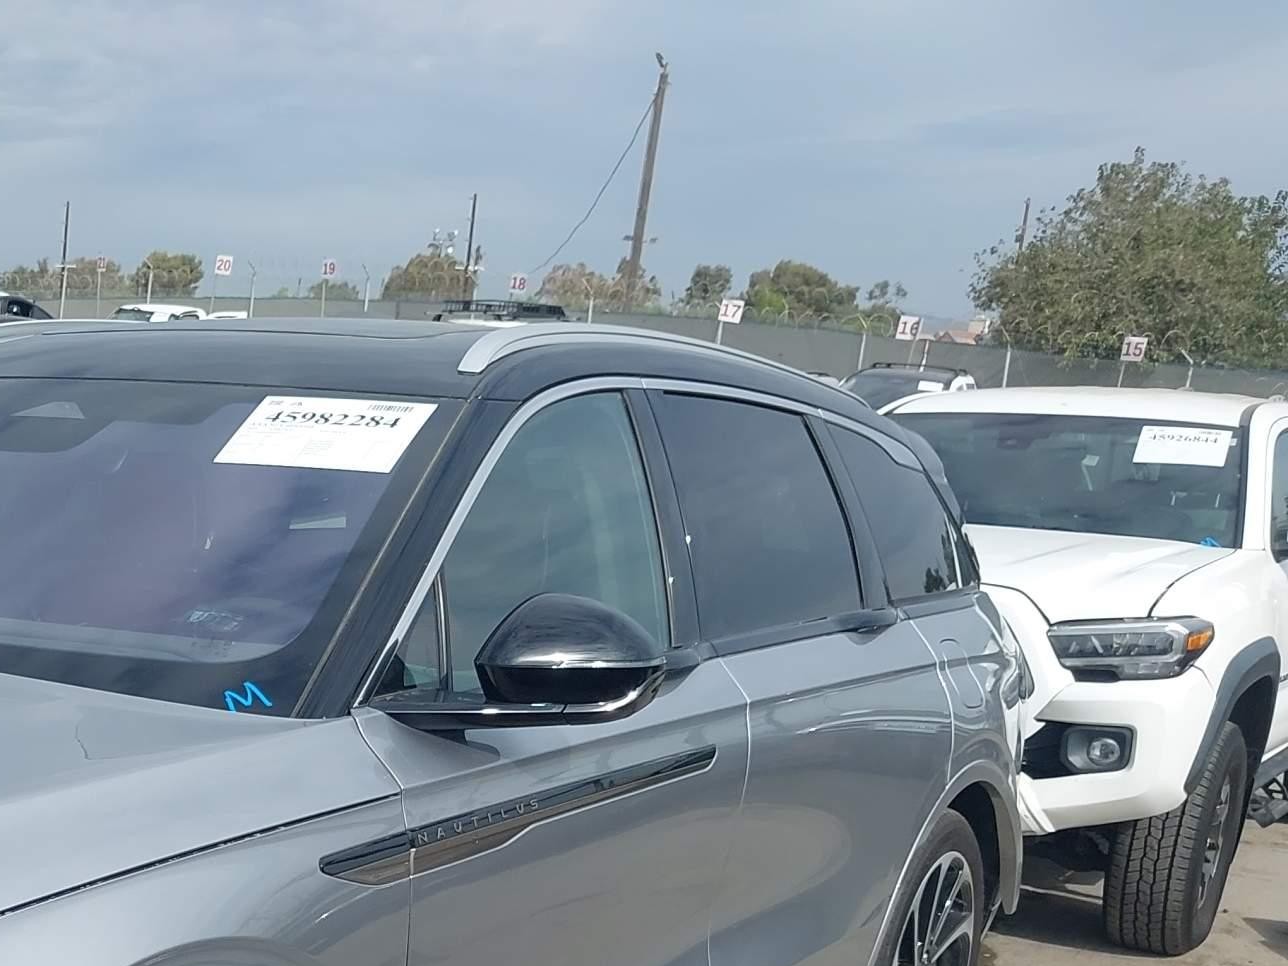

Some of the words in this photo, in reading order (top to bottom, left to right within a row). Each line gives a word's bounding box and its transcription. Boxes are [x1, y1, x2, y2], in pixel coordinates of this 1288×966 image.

[216, 259, 231, 272] 20
[322, 262, 336, 275] 19
[512, 276, 526, 290] 18
[721, 304, 741, 318] 17
[899, 321, 919, 337] 16
[1122, 342, 1144, 357] 15
[265, 410, 401, 428] 45982284
[1150, 432, 1219, 444] 45926844
[223, 681, 273, 713] M
[417, 799, 539, 845] NAUTILUS
